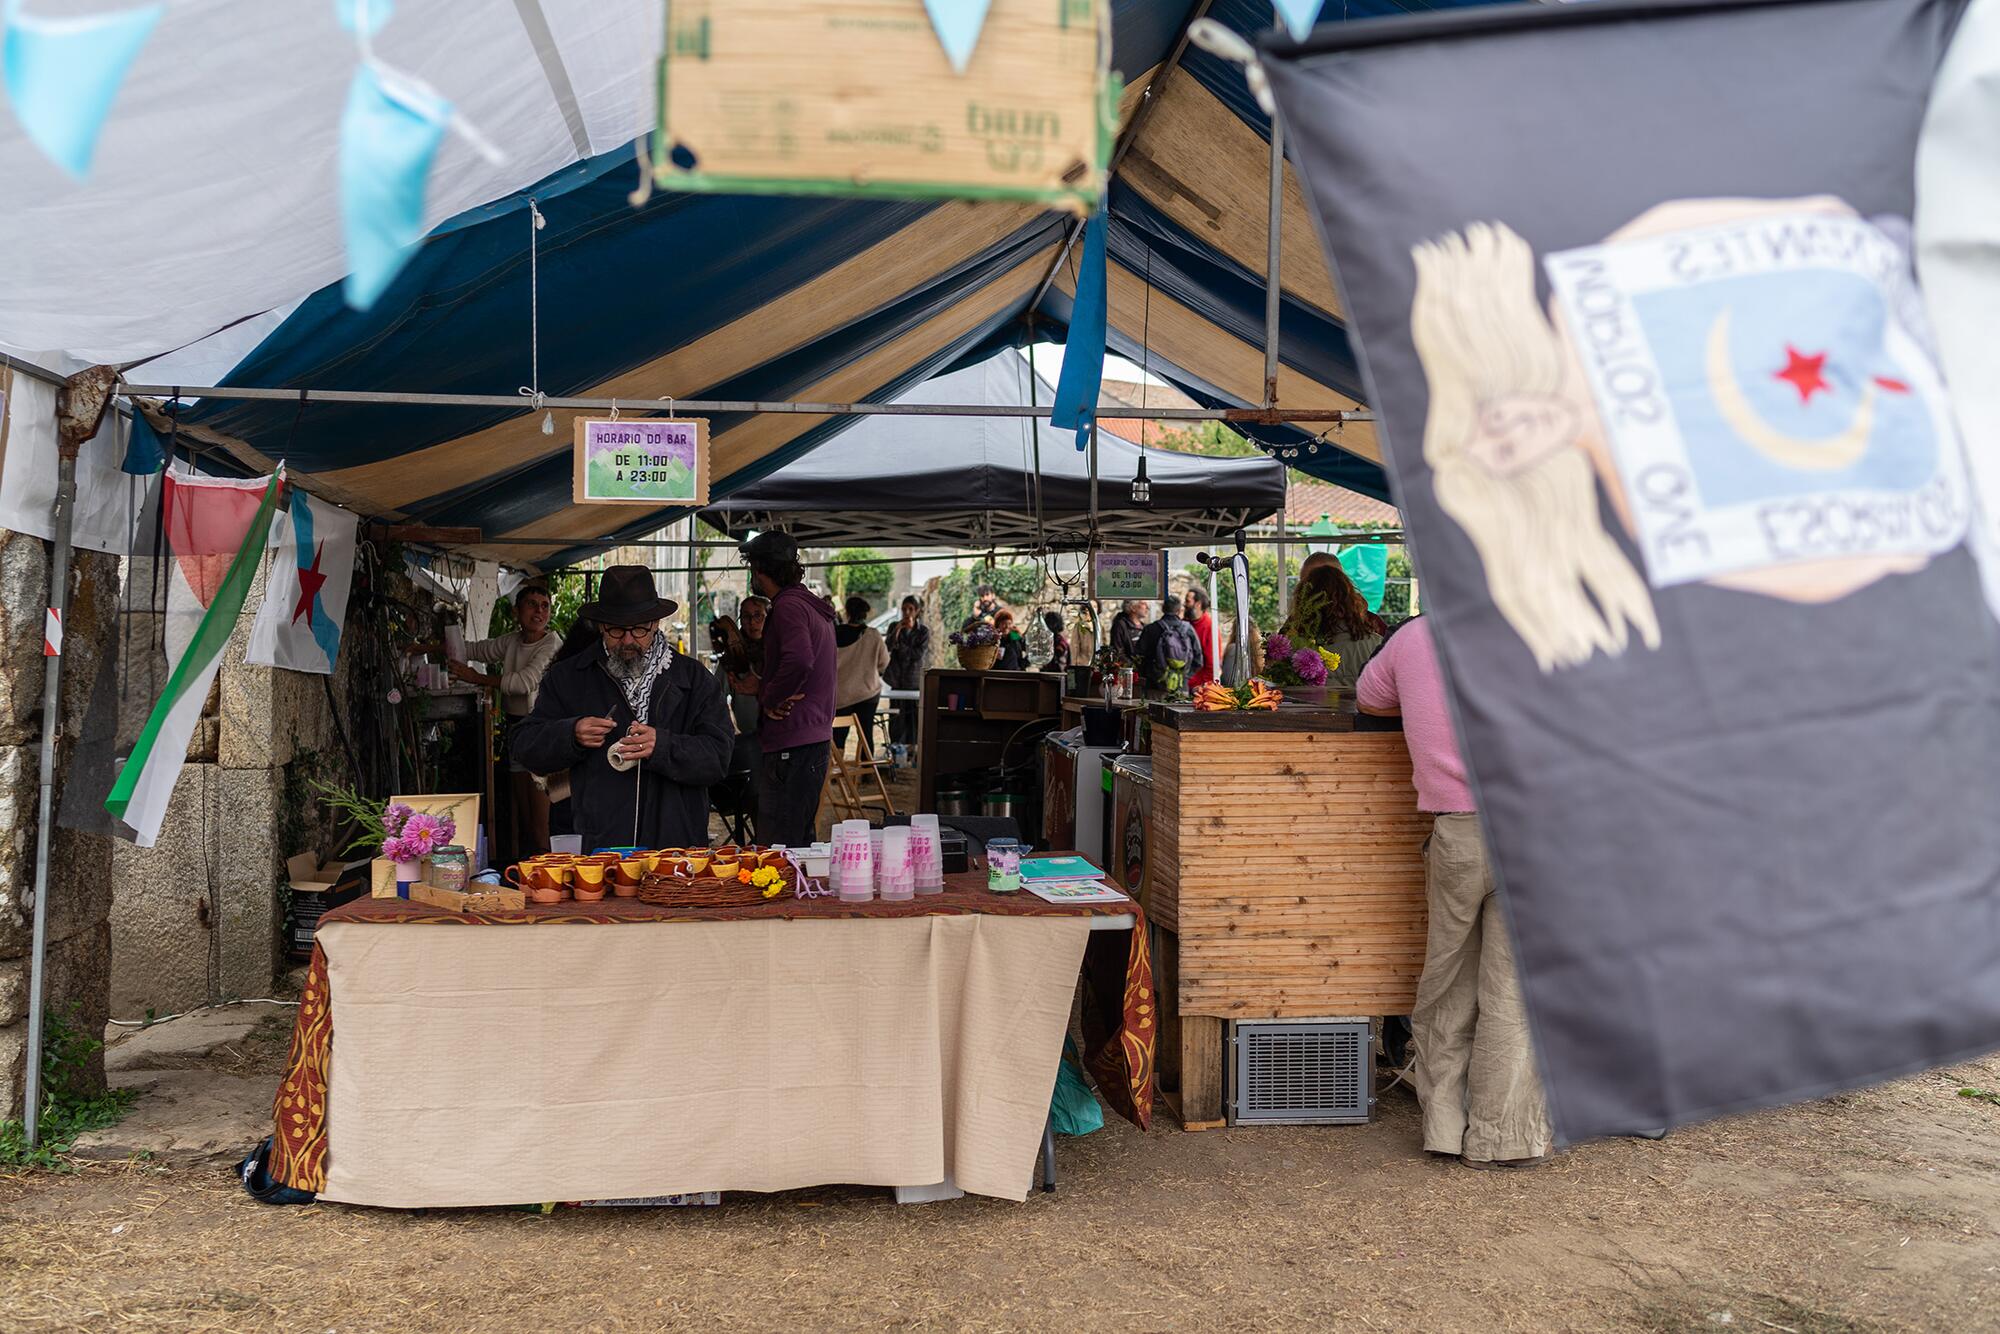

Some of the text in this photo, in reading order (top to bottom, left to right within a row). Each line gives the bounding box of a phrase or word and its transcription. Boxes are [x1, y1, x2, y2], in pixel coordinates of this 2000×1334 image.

[597, 433, 687, 444] HORARIO DO BAR
[615, 455, 668, 466] DE 11:00
[616, 470, 667, 482] A 23:00
[1111, 571, 1143, 579] DE 11:00
